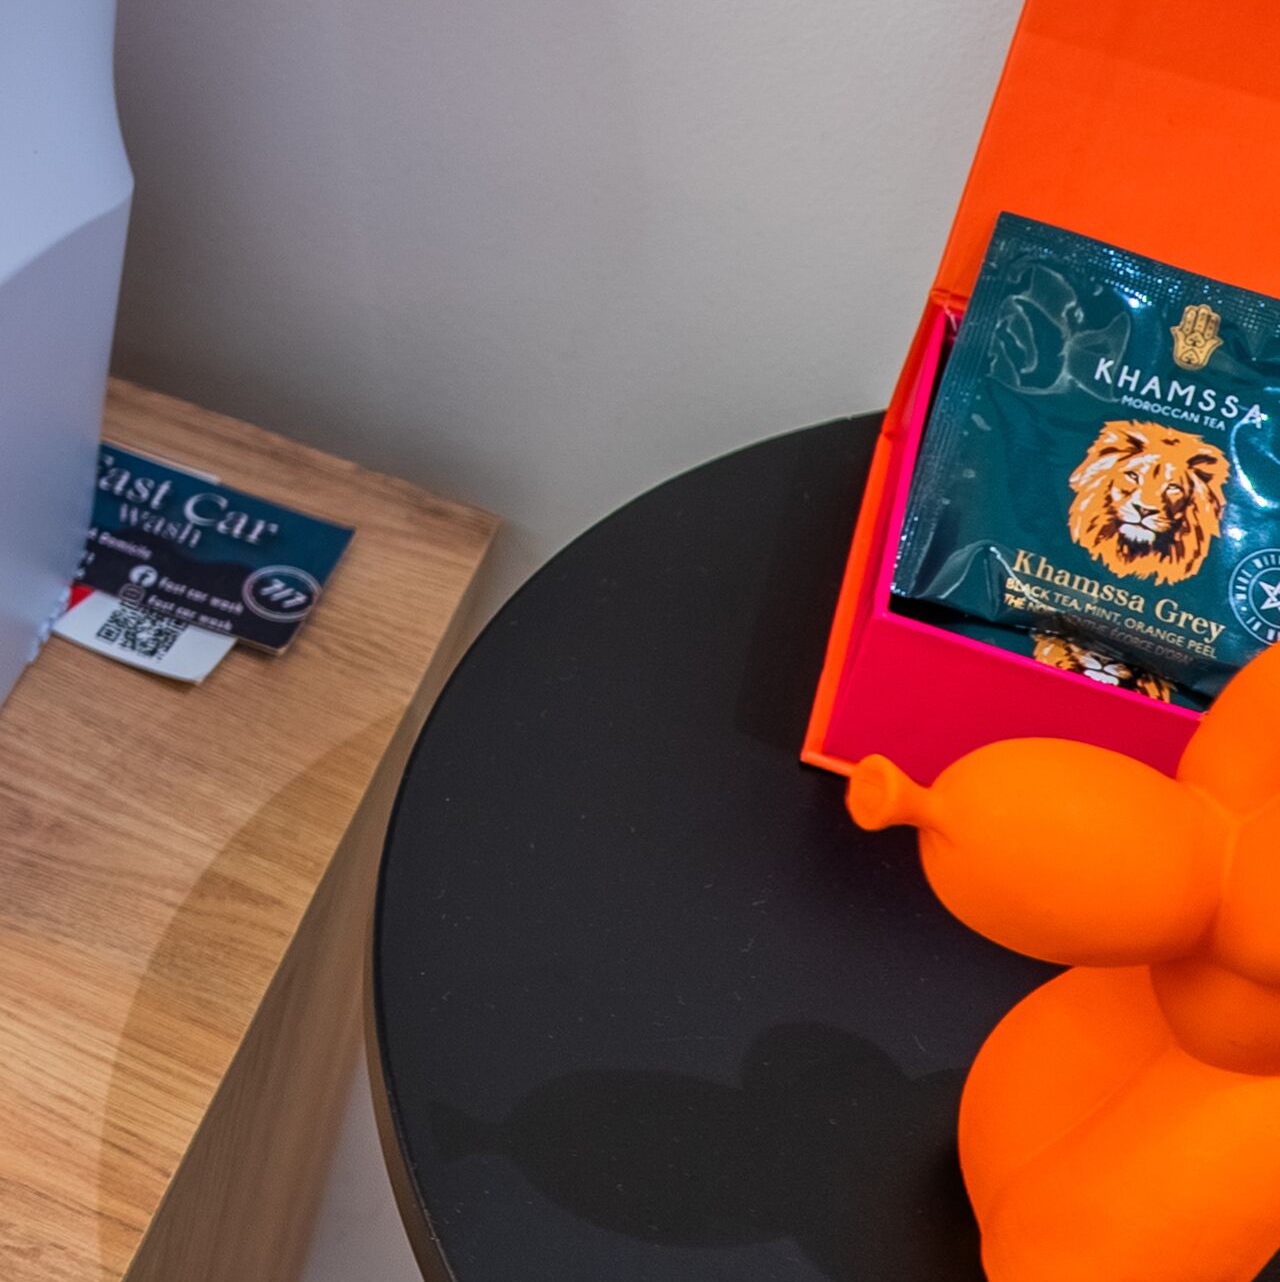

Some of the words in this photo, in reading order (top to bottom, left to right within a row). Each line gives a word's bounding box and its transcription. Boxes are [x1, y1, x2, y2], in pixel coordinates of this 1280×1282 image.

[1094, 357, 1263, 429] KHAMSSA
[1121, 394, 1200, 423] MOROCCAN
[1203, 415, 1226, 431] TEA
[98, 454, 173, 510] ast
[183, 492, 279, 546] Car
[261, 578, 307, 609] 7/7
[1005, 577, 1050, 602] BLACK
[1124, 617, 1184, 646] ORANGE
[1187, 639, 1217, 659] PEEL
[1013, 549, 1146, 613] Khamssa
[1155, 598, 1226, 644] Grey
